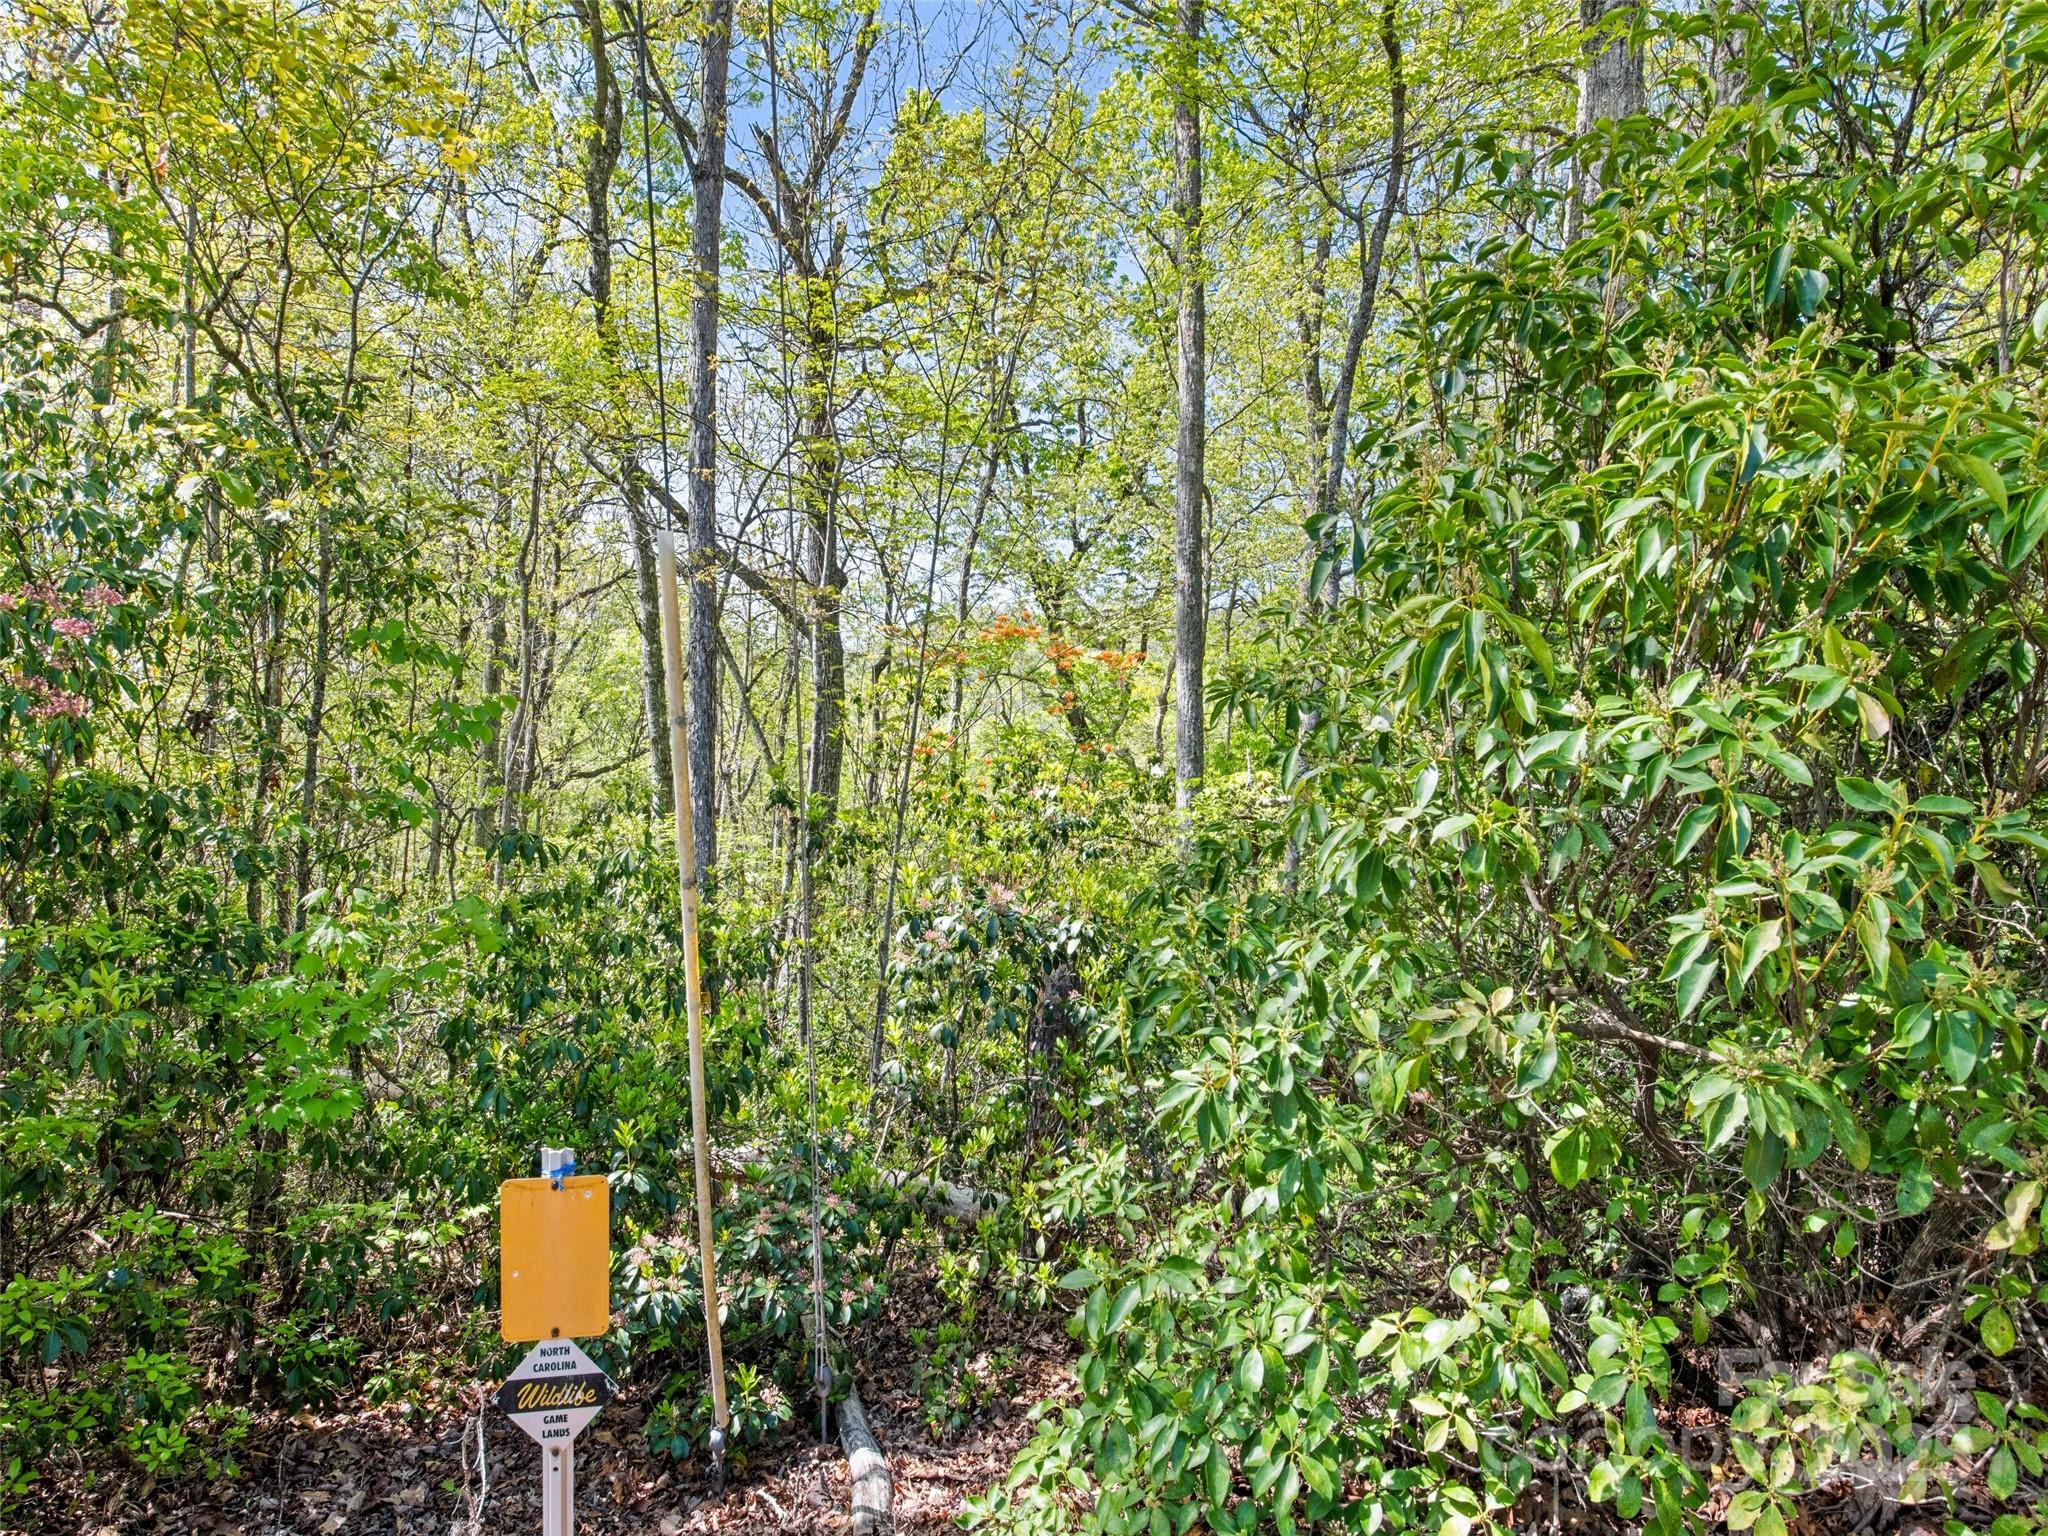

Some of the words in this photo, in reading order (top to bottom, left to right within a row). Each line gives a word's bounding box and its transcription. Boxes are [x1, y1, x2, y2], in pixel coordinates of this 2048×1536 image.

[540, 1346, 570, 1357] NORTH
[533, 1361, 577, 1373] CAROLINA
[517, 1381, 597, 1410] Wildlife
[543, 1414, 568, 1424] GAME
[542, 1428, 570, 1438] LANDS
